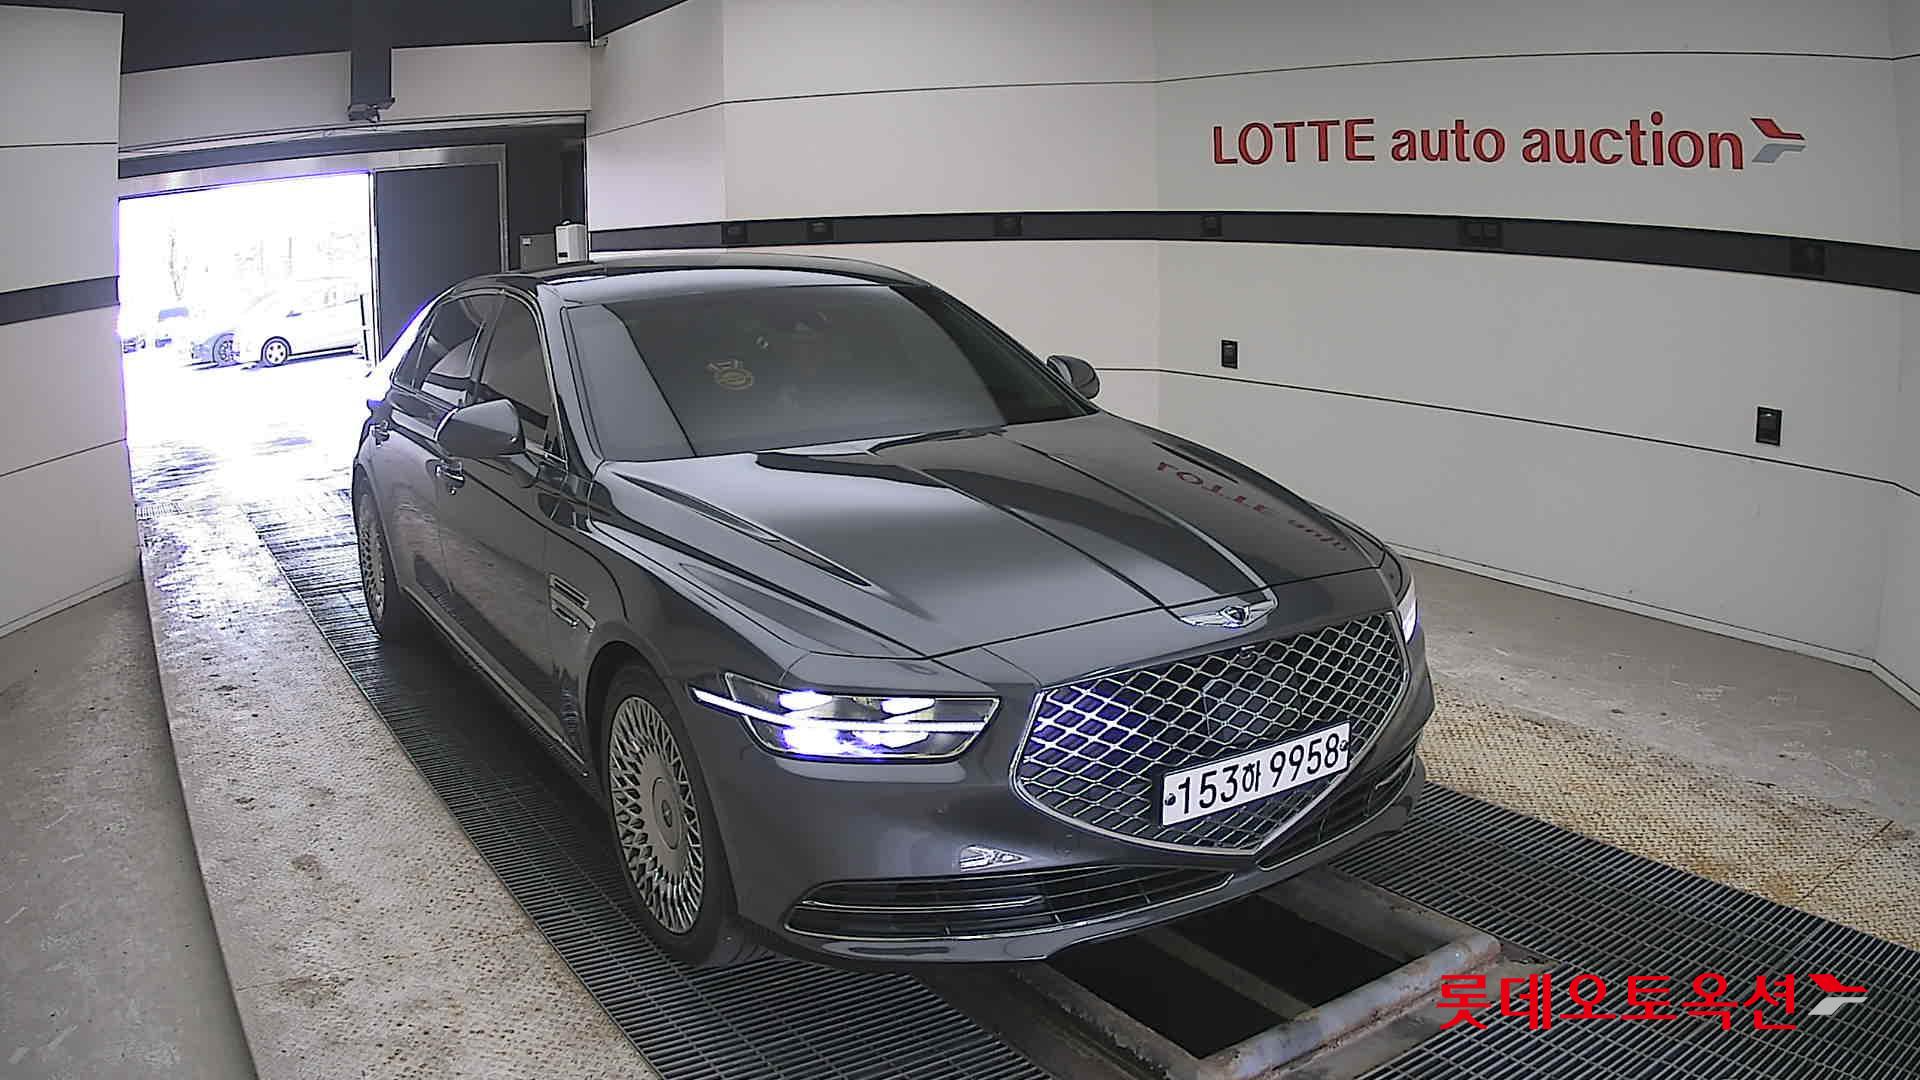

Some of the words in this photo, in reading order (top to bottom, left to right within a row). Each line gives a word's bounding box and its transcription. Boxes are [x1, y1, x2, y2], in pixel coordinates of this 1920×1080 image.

[1213, 118, 1376, 165] LOTTE
[1391, 119, 1506, 163] auto
[1521, 111, 1744, 169] auction
[1178, 760, 1262, 814] 153하
[1270, 733, 1340, 788] 9958
